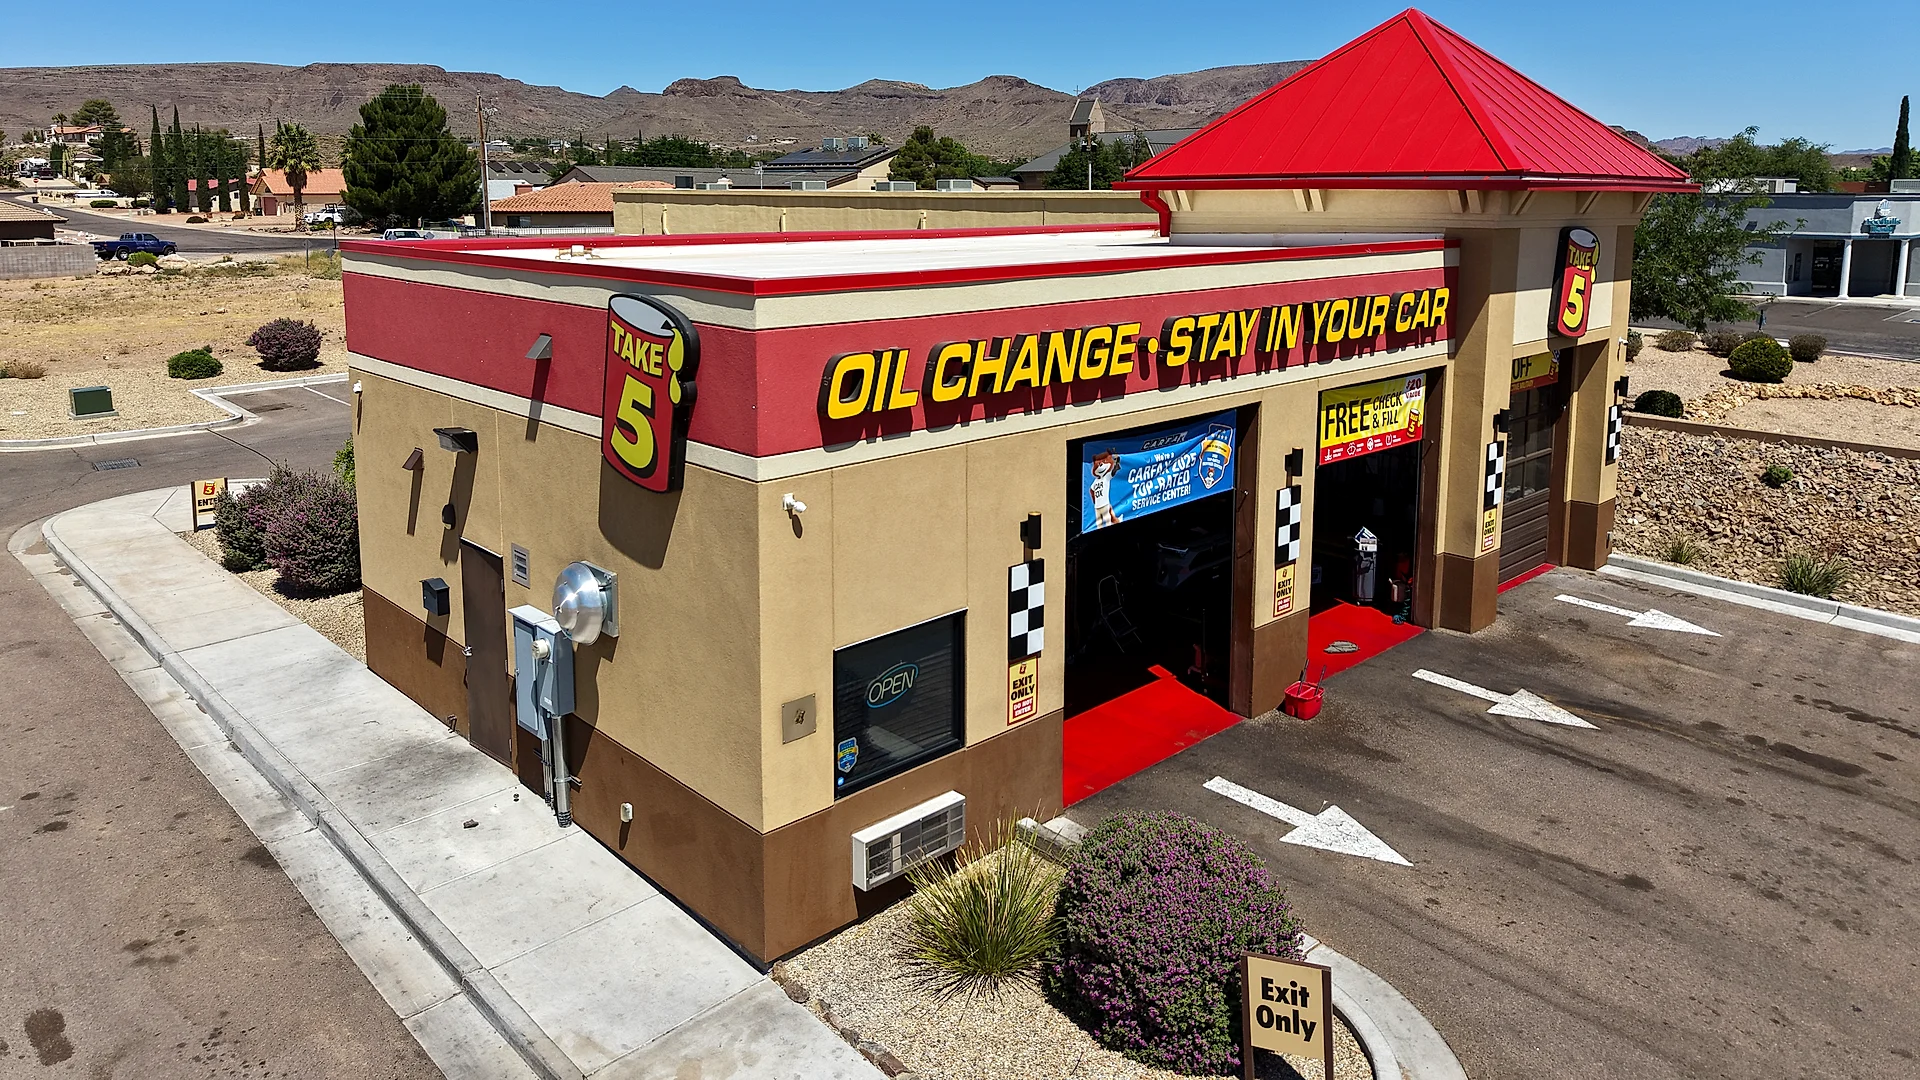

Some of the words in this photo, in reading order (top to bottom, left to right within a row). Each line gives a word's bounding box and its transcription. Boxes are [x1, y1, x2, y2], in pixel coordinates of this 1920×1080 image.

[1569, 246, 1592, 271] TAKE
[1562, 274, 1586, 329] 5
[611, 319, 664, 377] TAKE
[824, 348, 918, 420] OIL
[929, 322, 1141, 403] CHANGE
[1164, 309, 1260, 367] STAY
[1265, 304, 1303, 353] IN
[1312, 295, 1390, 345] YOUR
[1395, 287, 1450, 334] CAR
[1512, 356, 1532, 380] OFF
[1406, 378, 1422, 390] $20
[1373, 391, 1402, 411] CHECK
[610, 373, 656, 471] 5
[1325, 397, 1372, 440] FREE
[1373, 413, 1379, 428] &
[1382, 409, 1398, 427] FILL
[1409, 421, 1415, 432] 5
[1128, 460, 1171, 484] CARFAX
[1172, 452, 1197, 472] 2025
[204, 486, 213, 494] 5
[1132, 470, 1190, 498] TOP-RATED
[1132, 493, 1161, 511] SERVICE
[1162, 484, 1191, 502] CENTER!
[1277, 586, 1292, 598] ONLY
[1278, 578, 1291, 589] EXIT
[869, 669, 915, 703] OPEN
[1011, 684, 1035, 701] ONLY
[1013, 674, 1033, 690] EXIT
[1261, 976, 1310, 1008] Exit
[1256, 1004, 1317, 1043] Only
